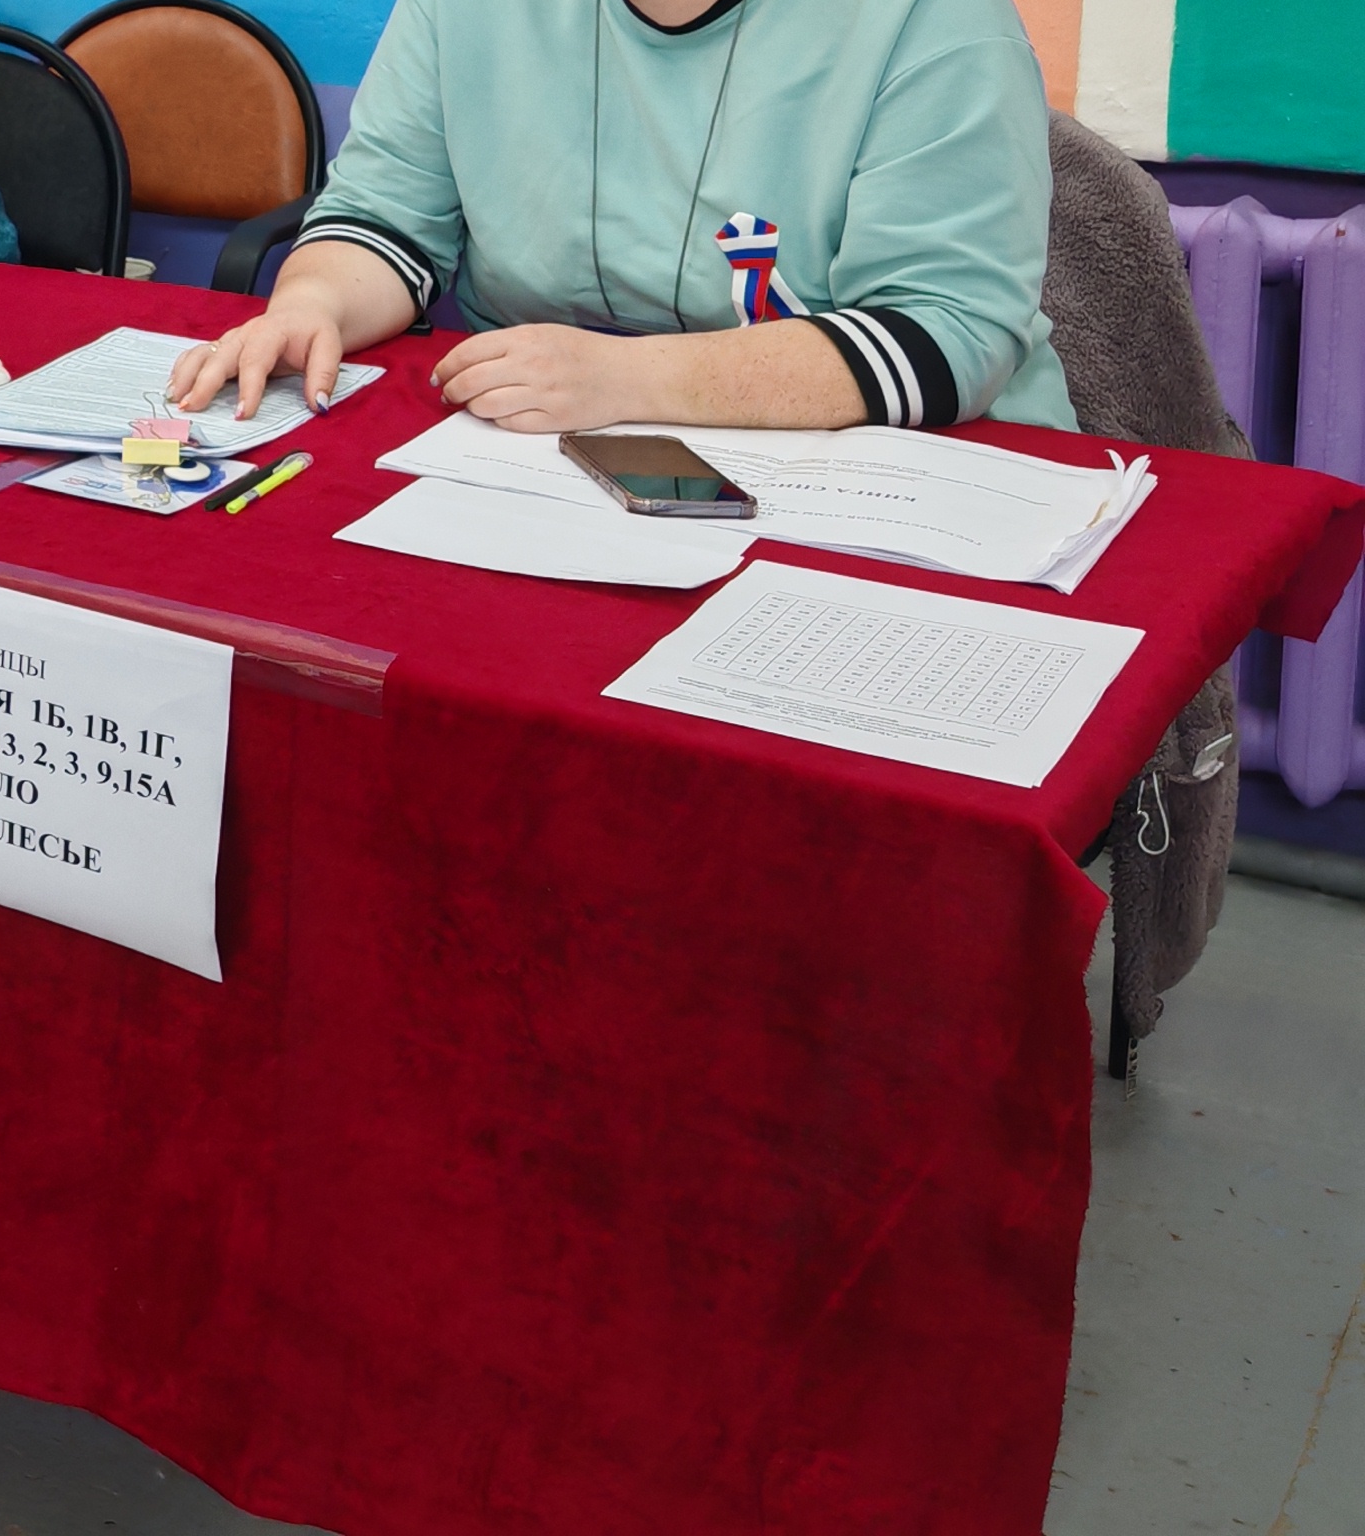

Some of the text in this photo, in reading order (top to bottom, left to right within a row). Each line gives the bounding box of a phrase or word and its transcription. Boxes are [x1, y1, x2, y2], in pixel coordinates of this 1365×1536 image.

[836, 486, 917, 503] КНИГА
[31, 699, 73, 737] 1Б,
[84, 714, 127, 753] 1В,
[138, 730, 182, 769] 1Г,
[33, 742, 56, 775] 2,
[64, 751, 88, 784] 3,
